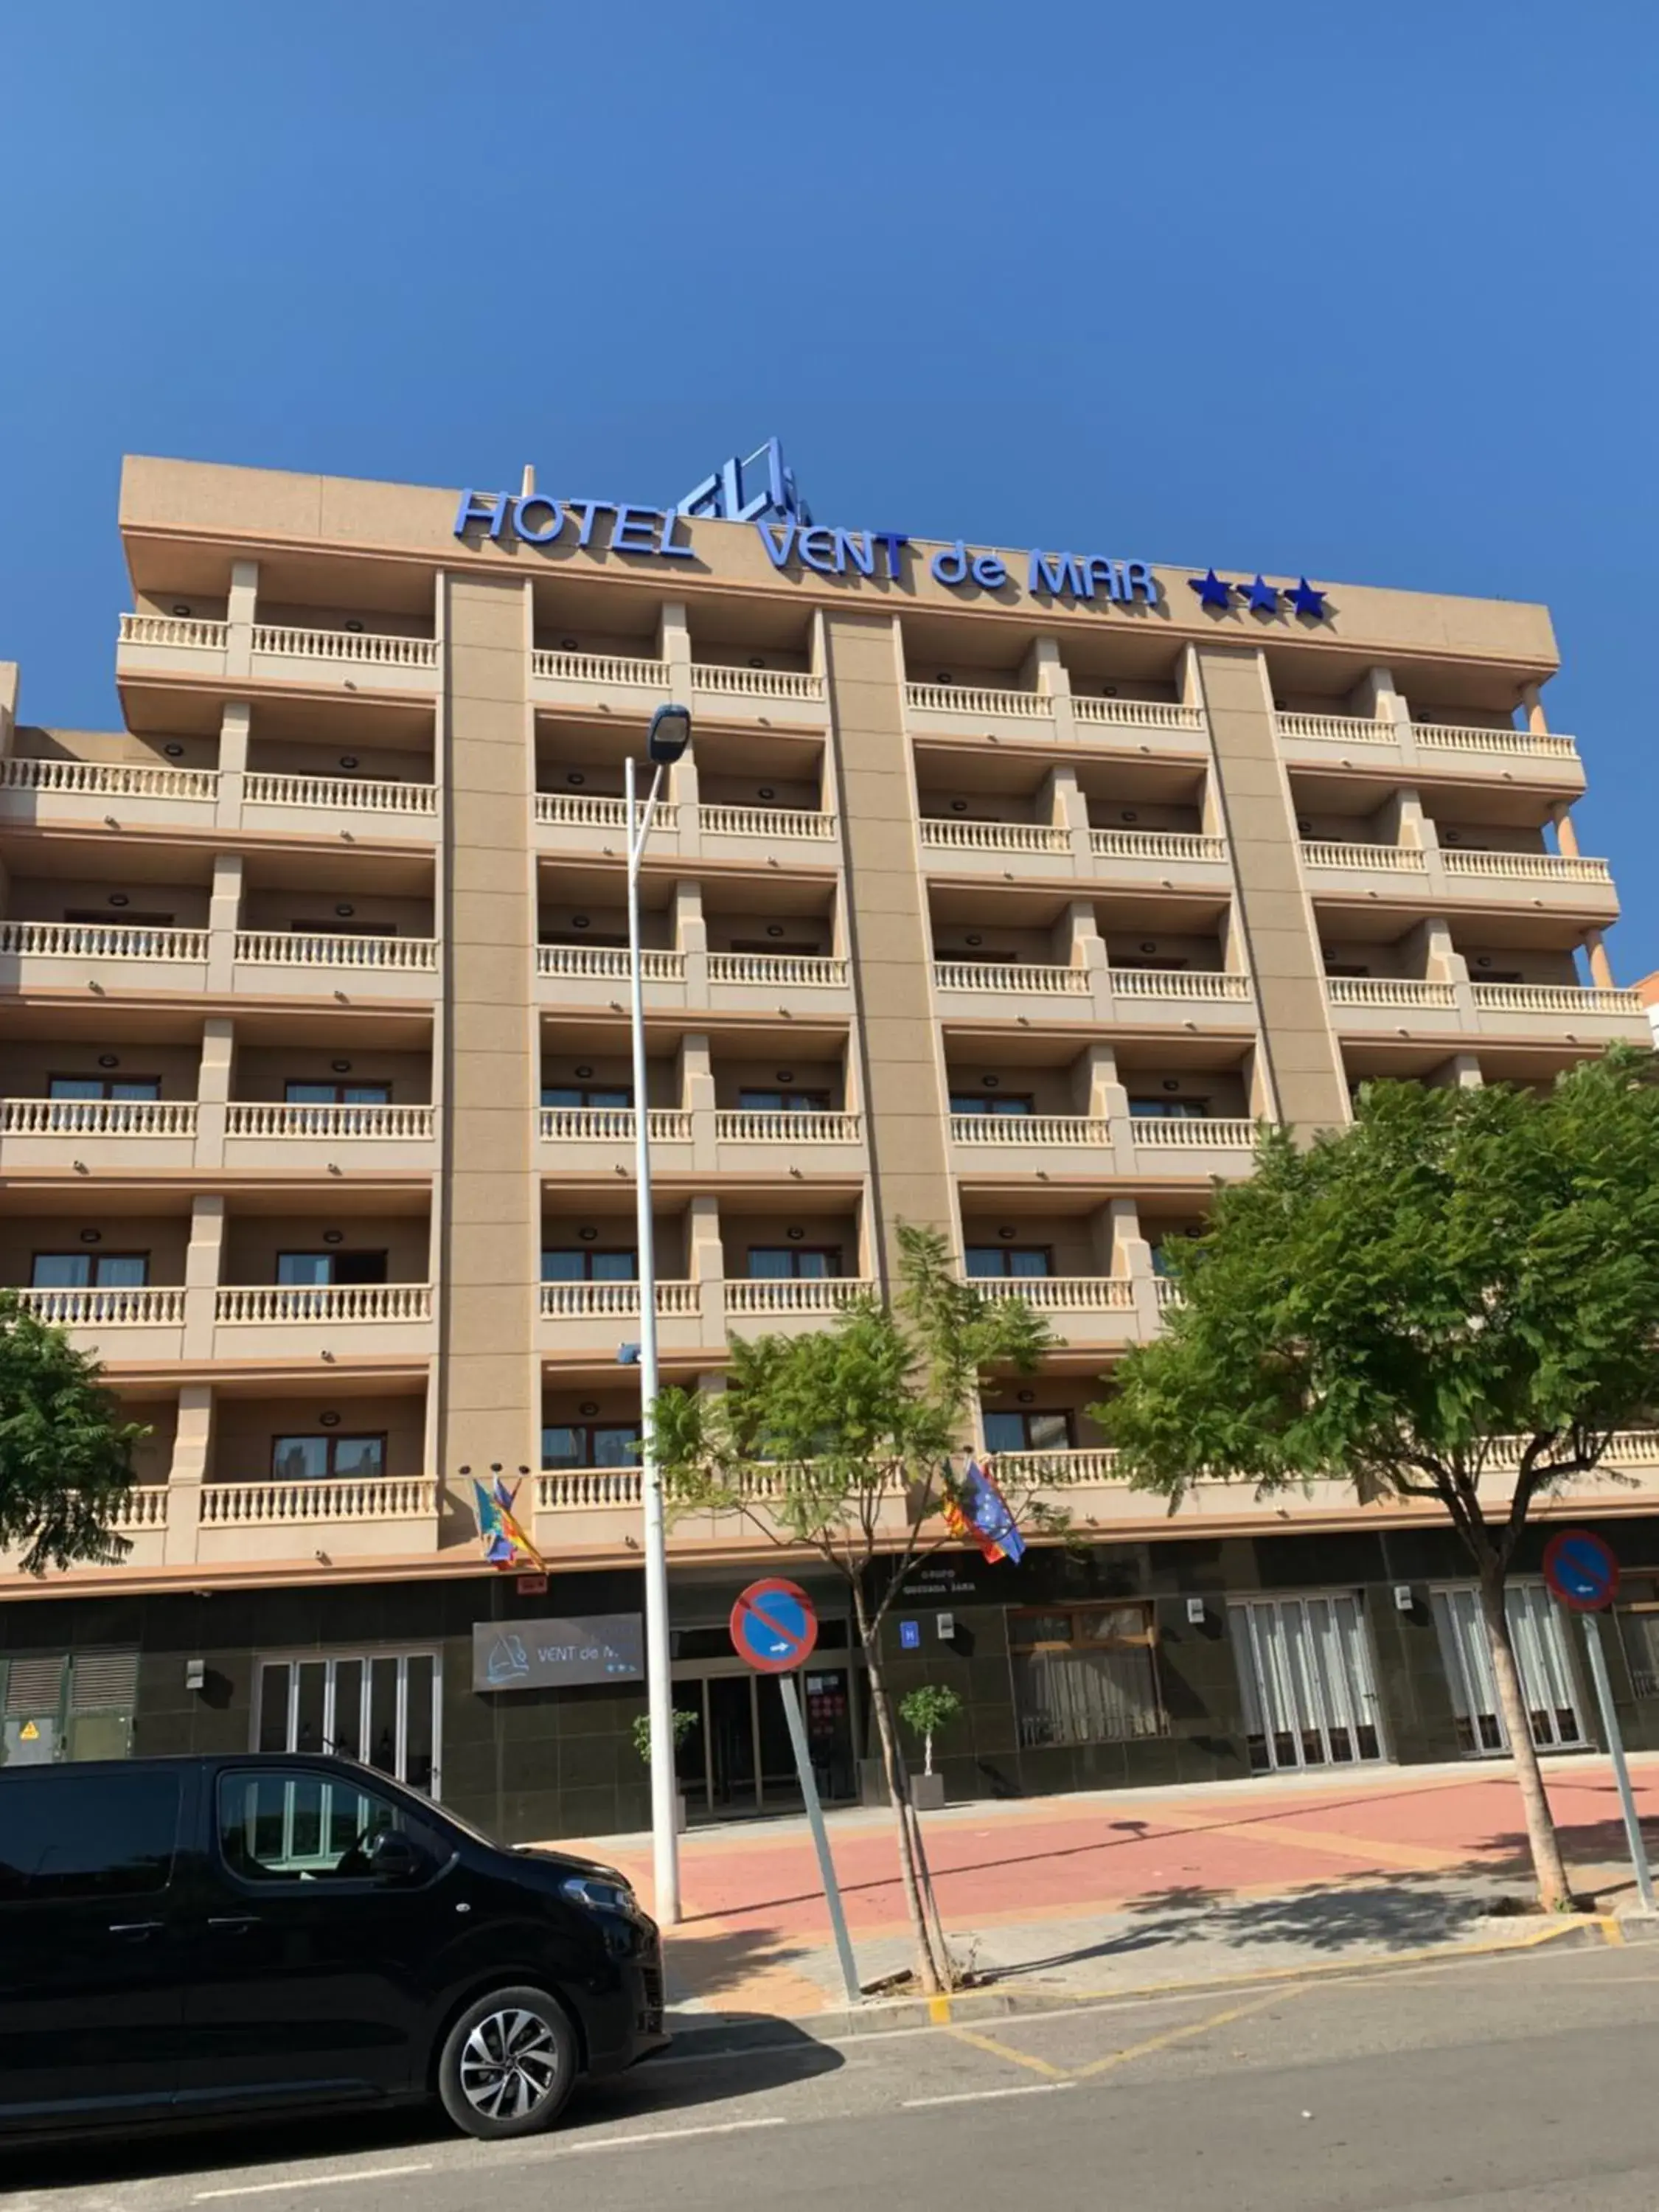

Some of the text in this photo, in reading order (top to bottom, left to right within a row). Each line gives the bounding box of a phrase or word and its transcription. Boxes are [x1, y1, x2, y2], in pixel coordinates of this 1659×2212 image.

[453, 488, 1158, 607] HOTEL VENT de MAR
[538, 1646, 577, 1662] VENT
